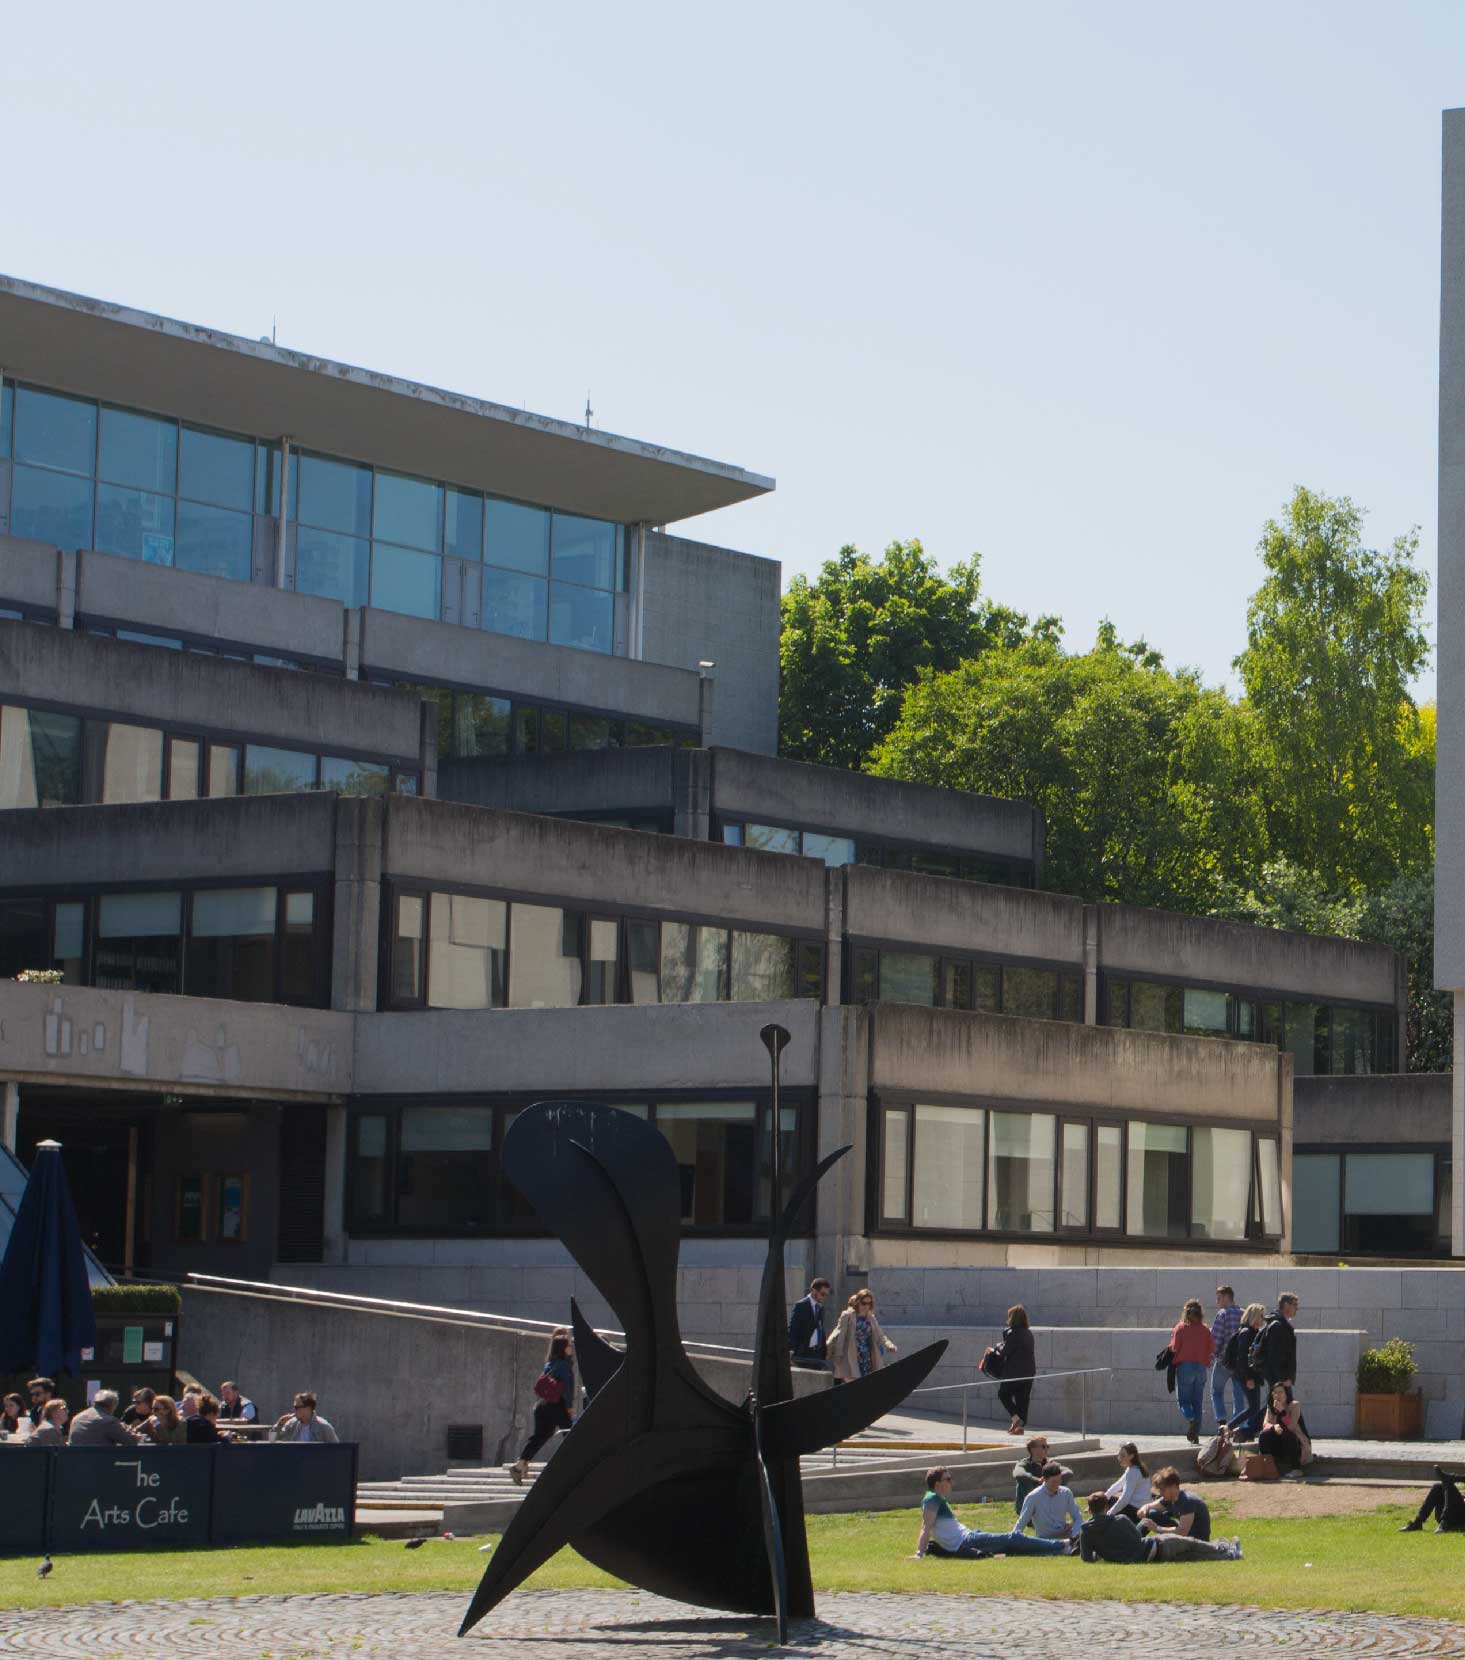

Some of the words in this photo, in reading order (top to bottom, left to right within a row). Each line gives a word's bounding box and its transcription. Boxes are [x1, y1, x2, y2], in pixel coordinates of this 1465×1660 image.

[114, 1460, 161, 1487] The
[80, 1497, 131, 1530] Arts
[135, 1496, 189, 1529] Cafe
[293, 1502, 345, 1523] LAVAZZA
